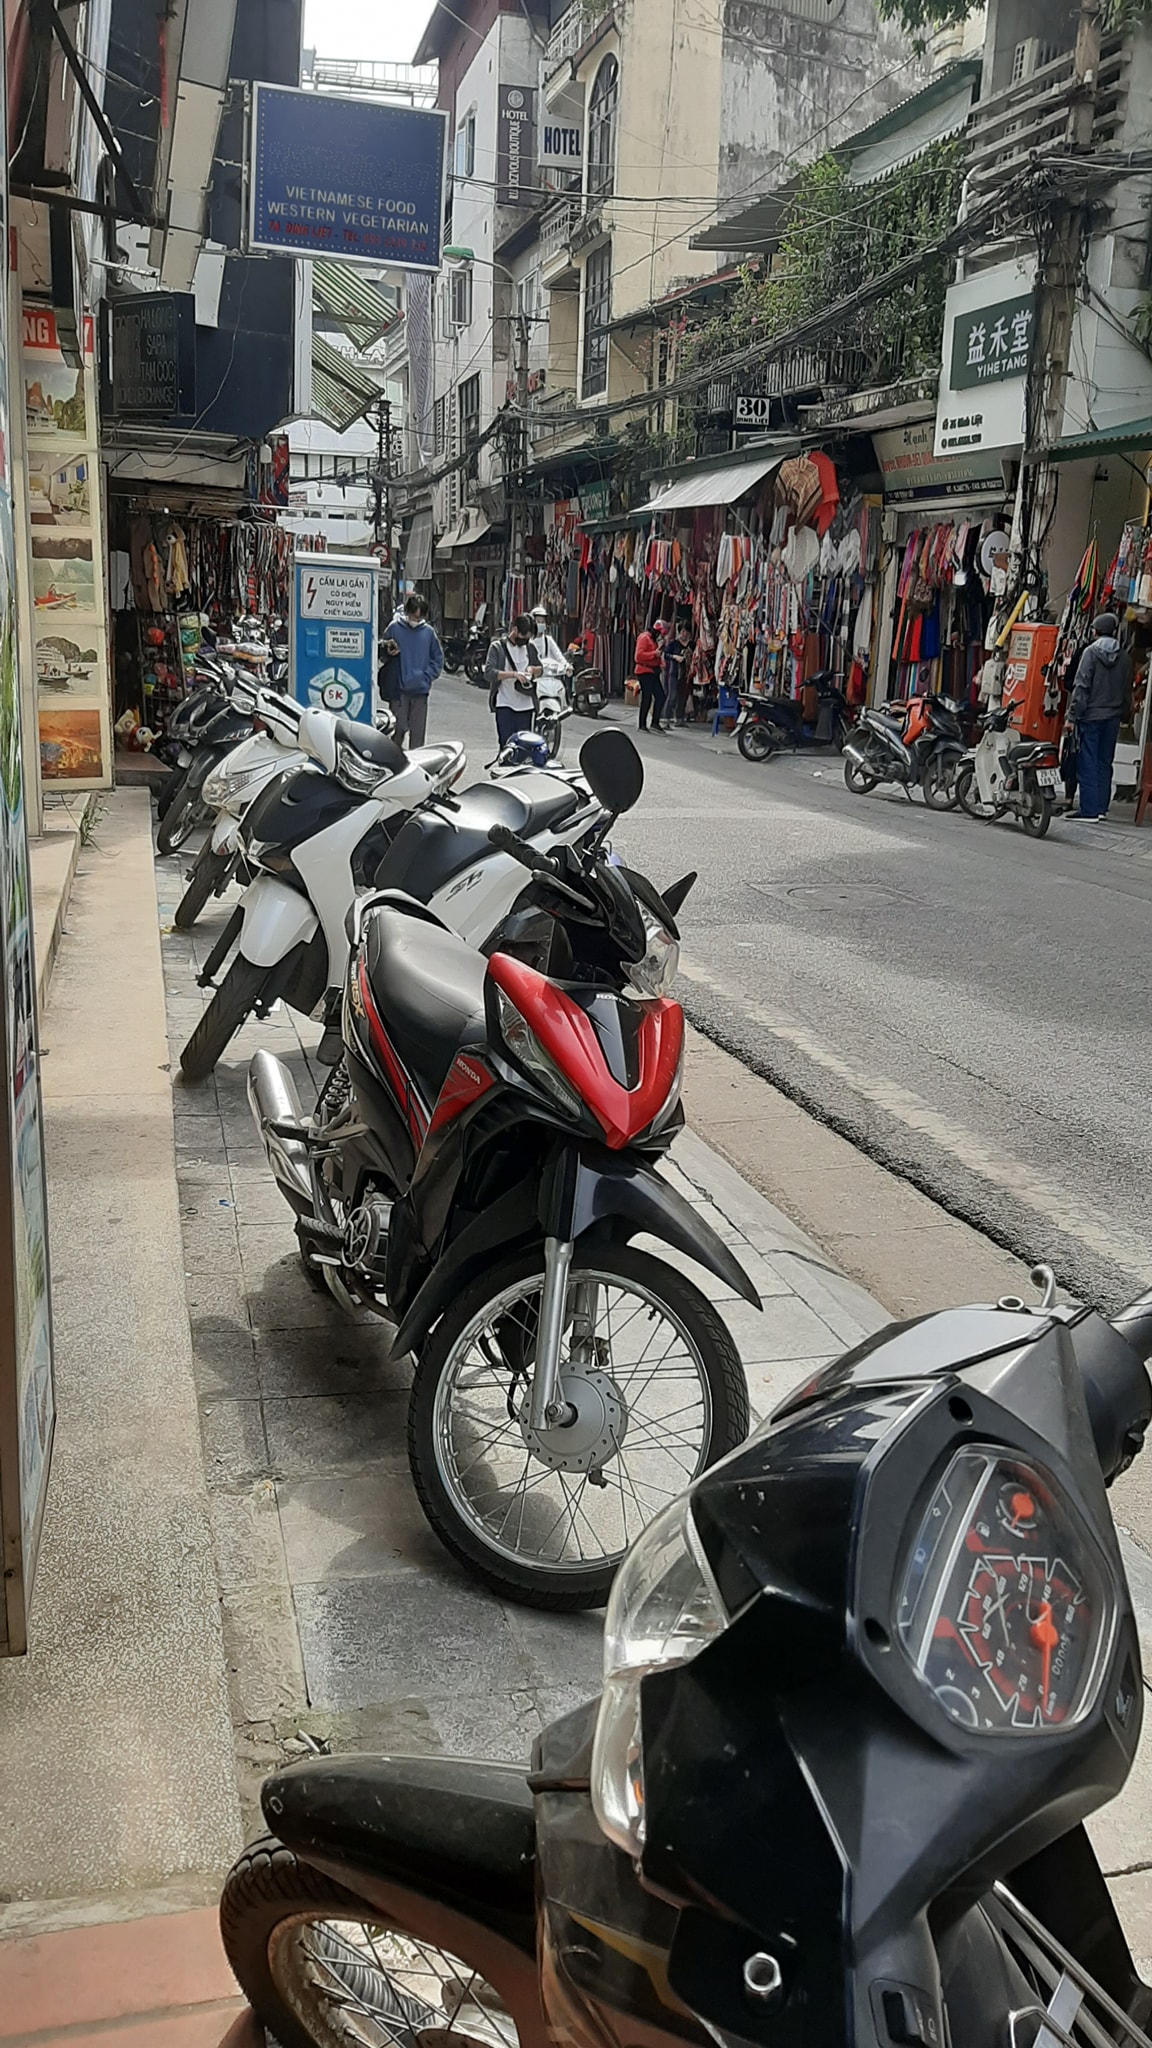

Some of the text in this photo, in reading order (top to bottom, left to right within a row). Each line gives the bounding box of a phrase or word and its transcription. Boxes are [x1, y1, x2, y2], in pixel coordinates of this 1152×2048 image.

[502, 109, 528, 121] HOTEL
[543, 126, 581, 156] HOTEL
[286, 185, 416, 215] VIETNAMESE FOOD
[267, 202, 429, 234] WESTERN VEGETARIAN
[966, 309, 1033, 366] 益禾堂
[739, 398, 767, 417] 30
[456, 1057, 481, 1085] HONDA
[1018, 1573, 1029, 1593] 120
[995, 1649, 1006, 1668] 40
[945, 1667, 956, 1681] 2
[1018, 1673, 1029, 1692] 20
